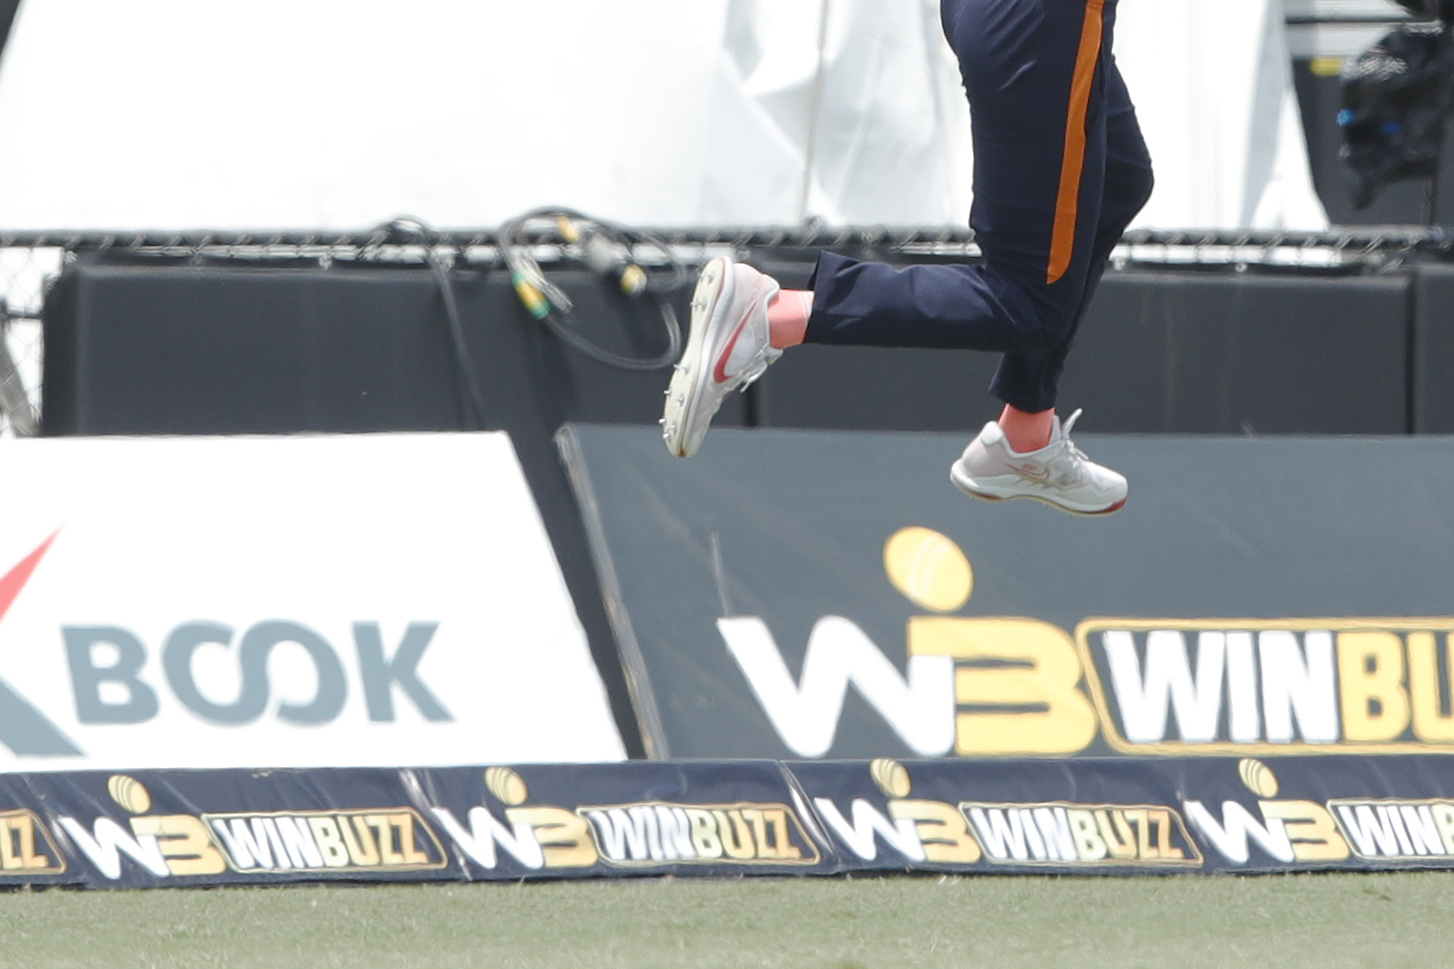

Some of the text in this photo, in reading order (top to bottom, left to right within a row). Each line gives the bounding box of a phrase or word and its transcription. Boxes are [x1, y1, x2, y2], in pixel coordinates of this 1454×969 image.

[212, 814, 429, 869] WINBUZZ
[588, 805, 801, 860] WINBUZZ
[969, 806, 1184, 862] WINBUZZ
